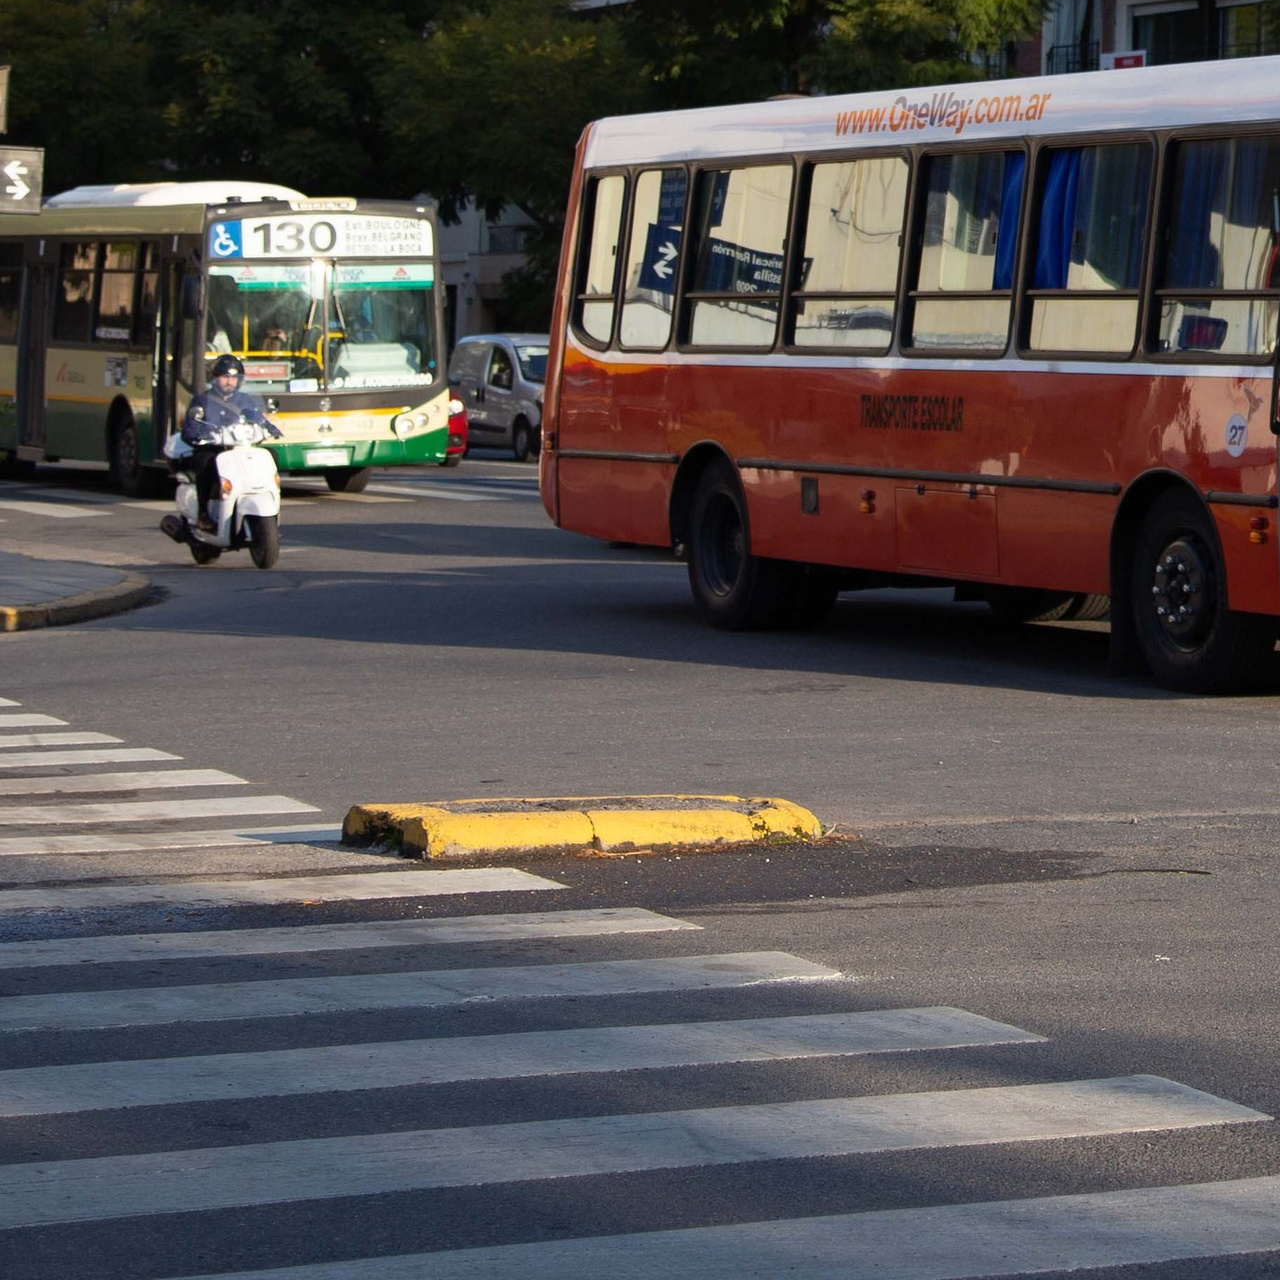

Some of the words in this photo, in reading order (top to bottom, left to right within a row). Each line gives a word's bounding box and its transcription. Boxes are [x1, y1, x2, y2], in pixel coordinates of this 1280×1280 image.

[835, 91, 1052, 135] www.OneWay.com.ar
[253, 221, 337, 254] 130
[366, 220, 421, 230] BOULOGNE
[371, 232, 423, 242] BELGRANO
[860, 394, 919, 430] TRANSPORTE
[920, 395, 964, 432] ESCOLAR
[1228, 424, 1246, 446] 27
